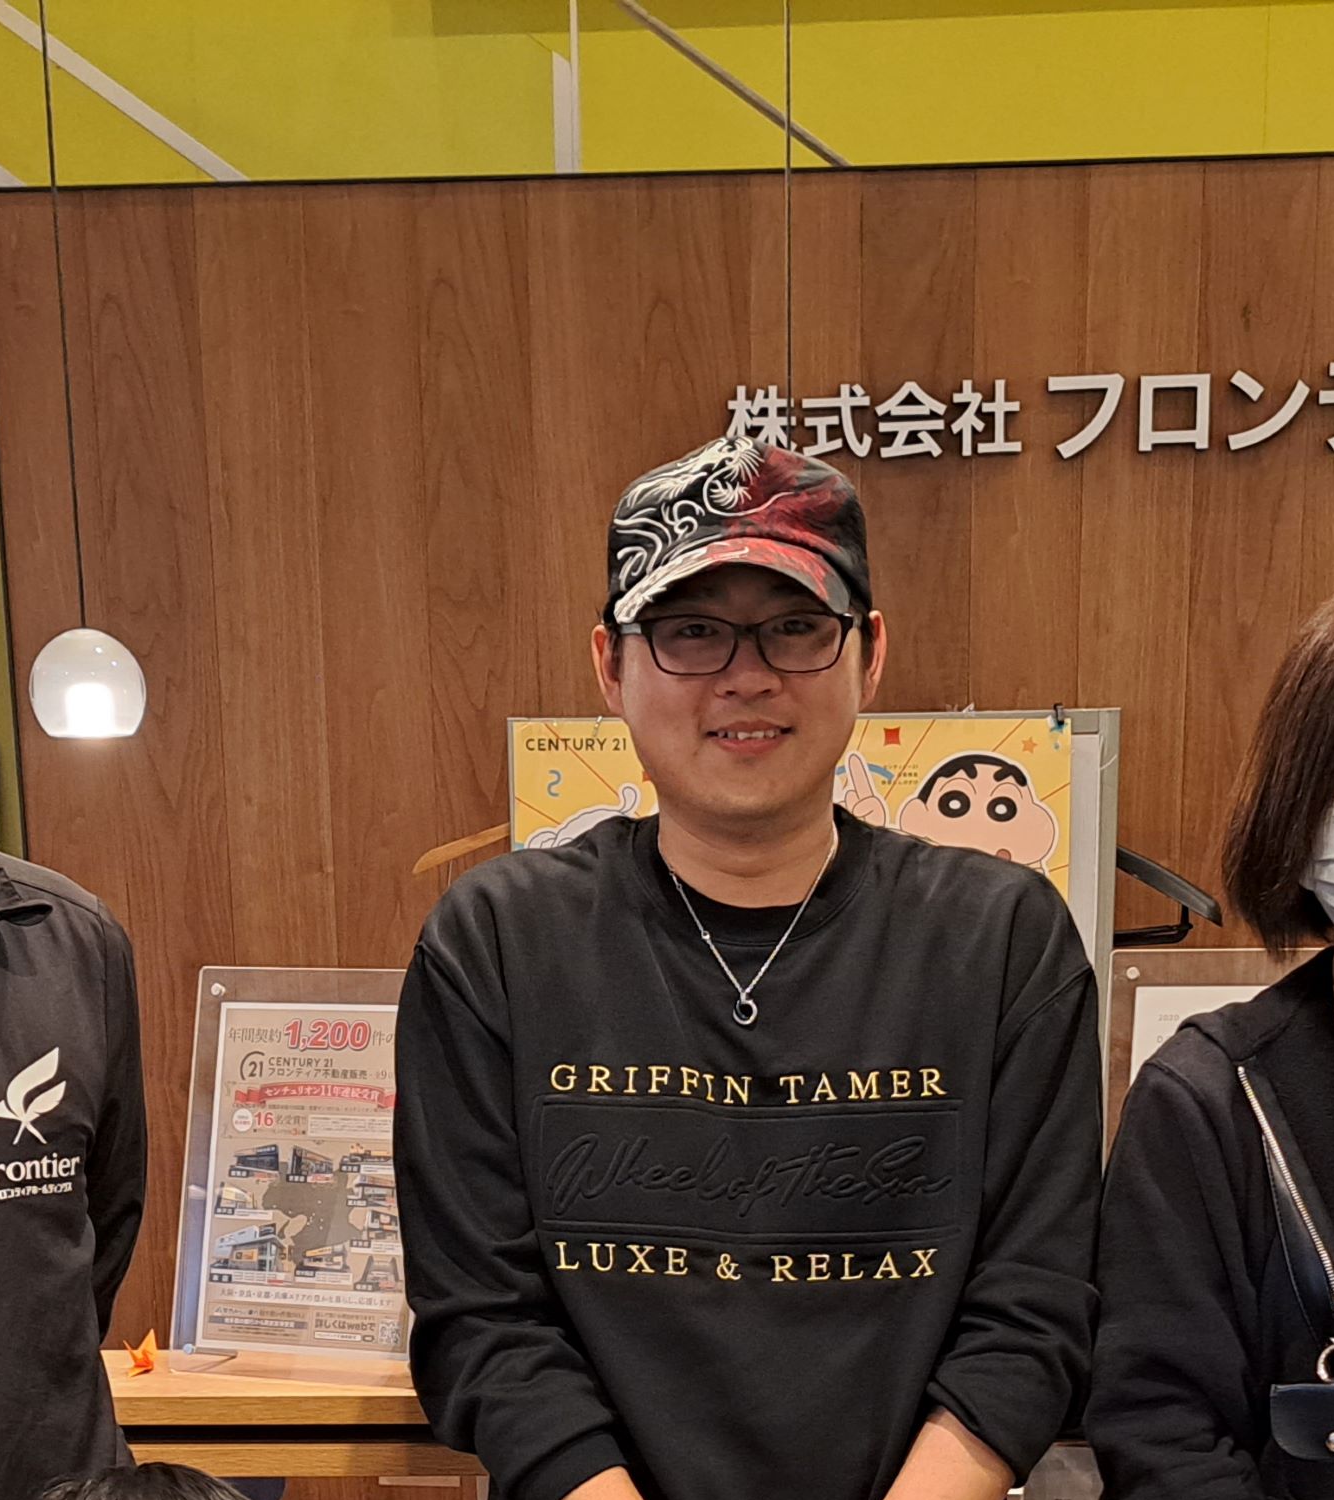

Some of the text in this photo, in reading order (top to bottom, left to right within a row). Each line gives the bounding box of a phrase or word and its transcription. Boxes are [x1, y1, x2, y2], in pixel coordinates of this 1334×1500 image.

[726, 381, 1024, 459] 株式会社
[525, 738, 627, 751] CENTURY 21
[268, 1057, 334, 1068] CENTURY 21
[268, 1068, 368, 1080] フロンティア不動産販売
[550, 1064, 948, 1105] GRIFFIN TAMER
[544, 1132, 731, 1216] Wheel
[555, 1241, 939, 1283] LUXE & RELAX
